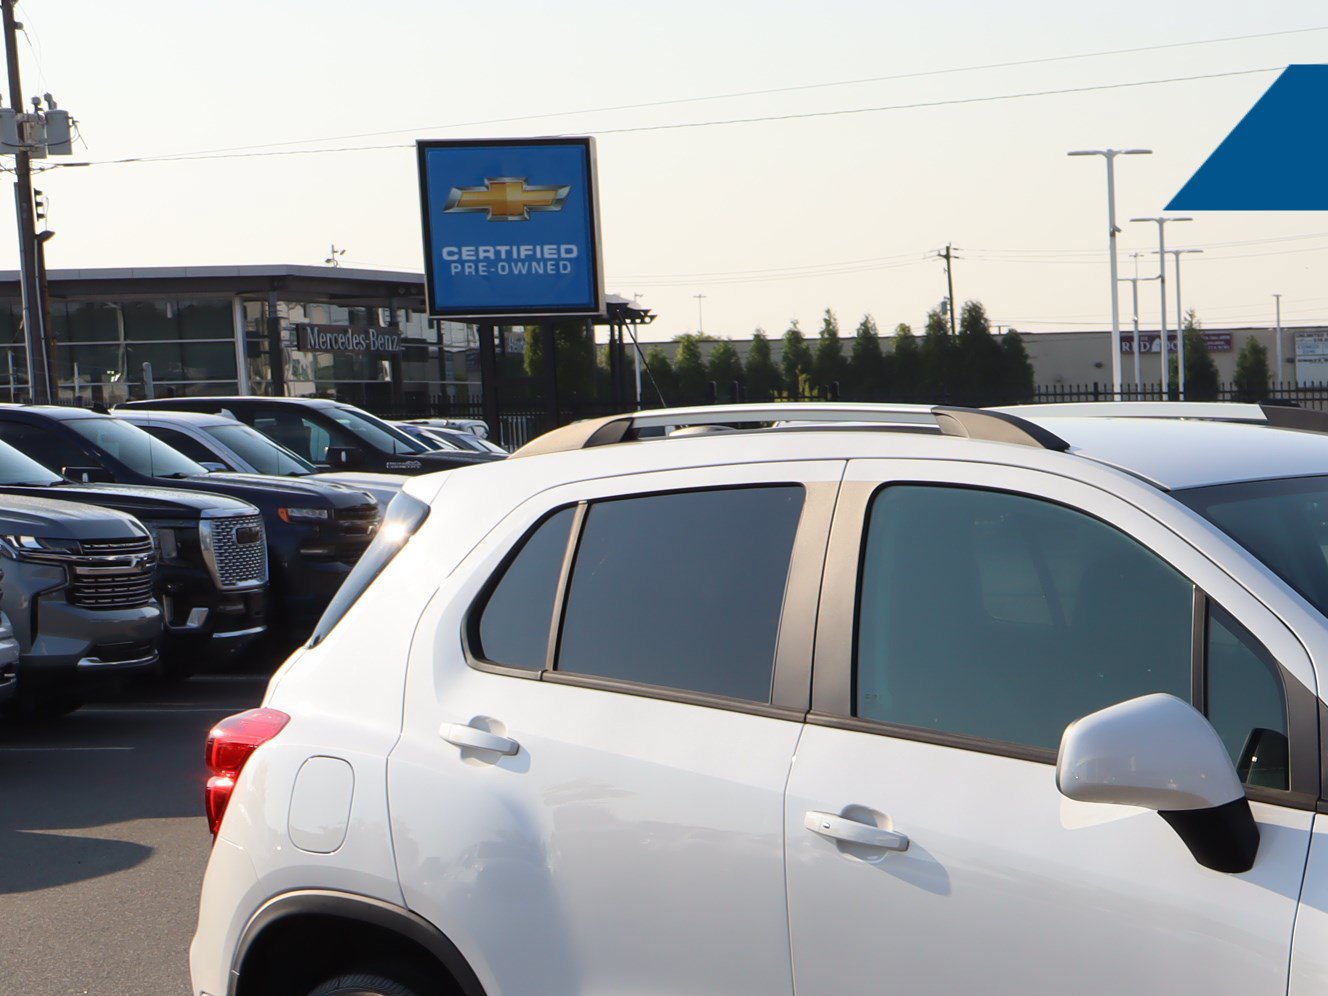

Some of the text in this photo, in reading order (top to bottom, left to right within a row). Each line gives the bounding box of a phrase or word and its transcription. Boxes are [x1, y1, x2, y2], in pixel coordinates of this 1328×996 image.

[441, 244, 579, 261] CERTIFIED
[450, 260, 572, 276] PRE-OWNED
[306, 326, 400, 352] Mercedes-Benz
